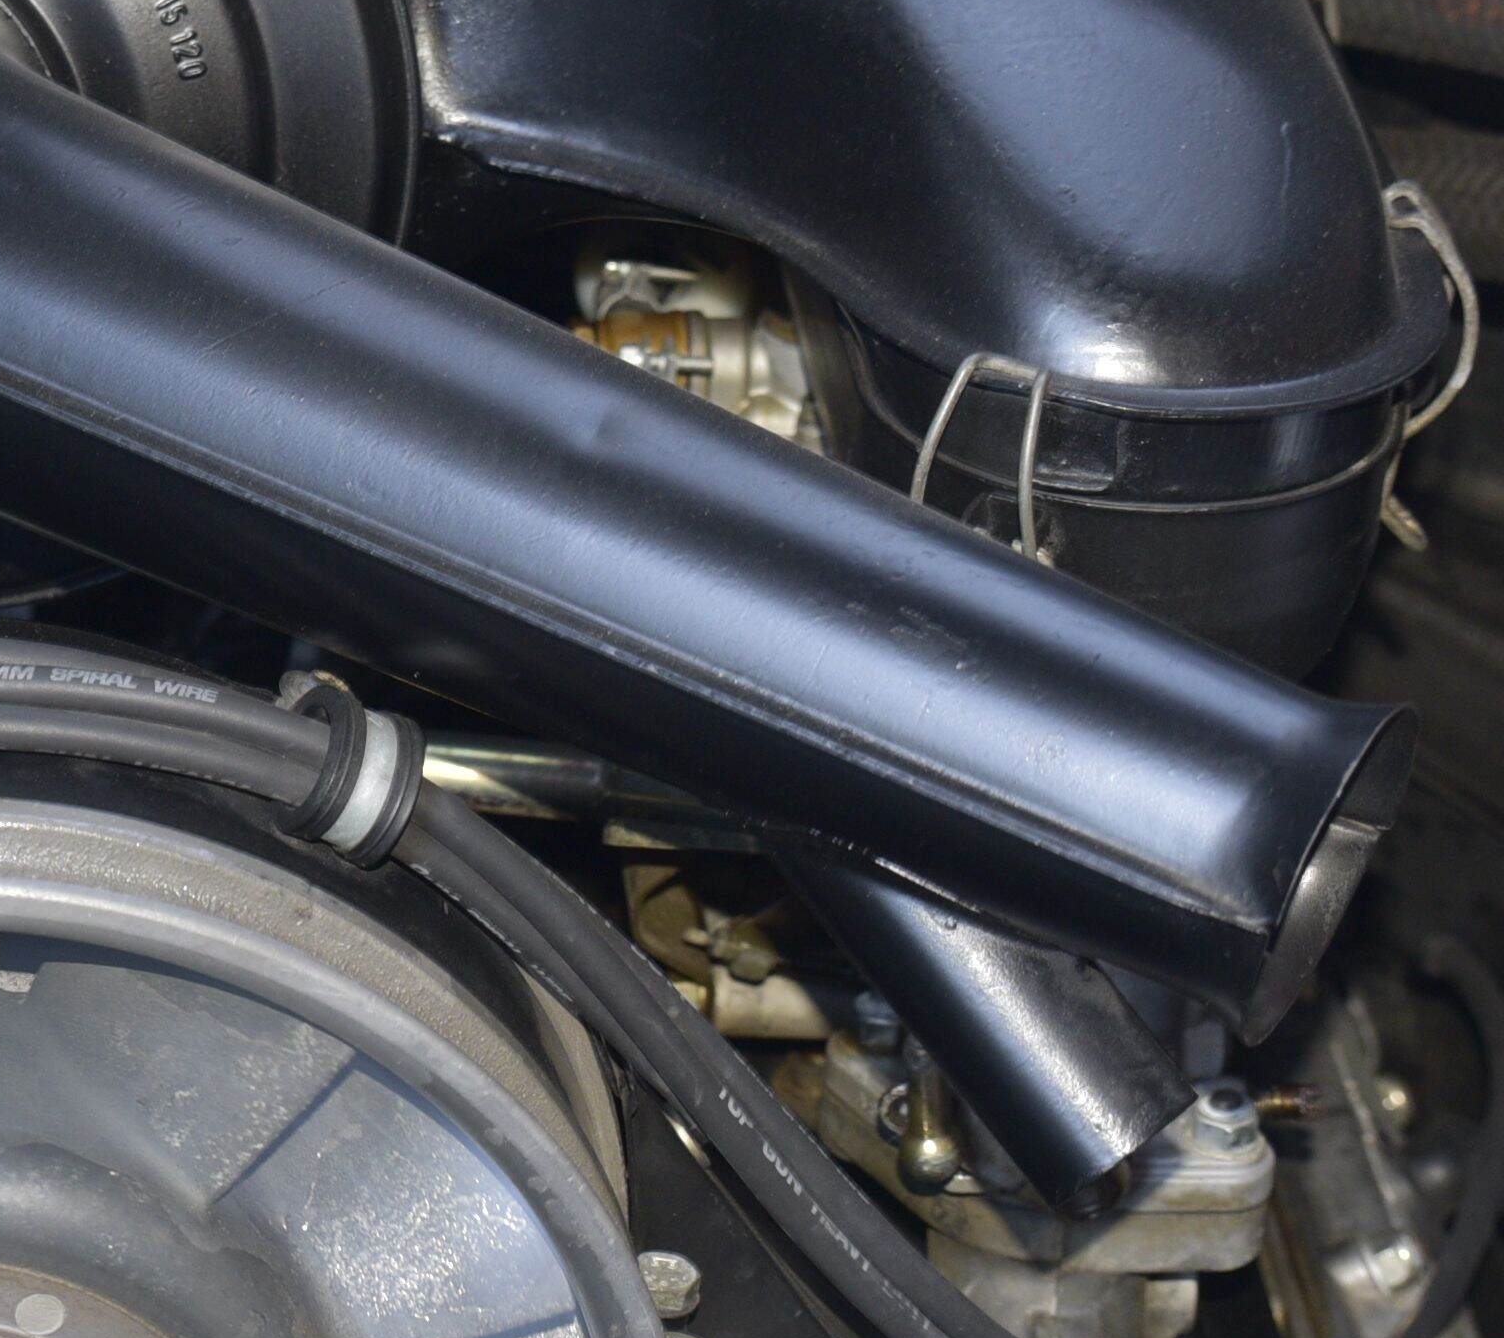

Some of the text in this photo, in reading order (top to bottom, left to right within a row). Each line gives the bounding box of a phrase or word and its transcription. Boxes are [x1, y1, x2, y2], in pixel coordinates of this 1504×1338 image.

[169, 26, 208, 81] 120
[48, 667, 140, 690] SPIRAL
[153, 679, 220, 704] WIRE
